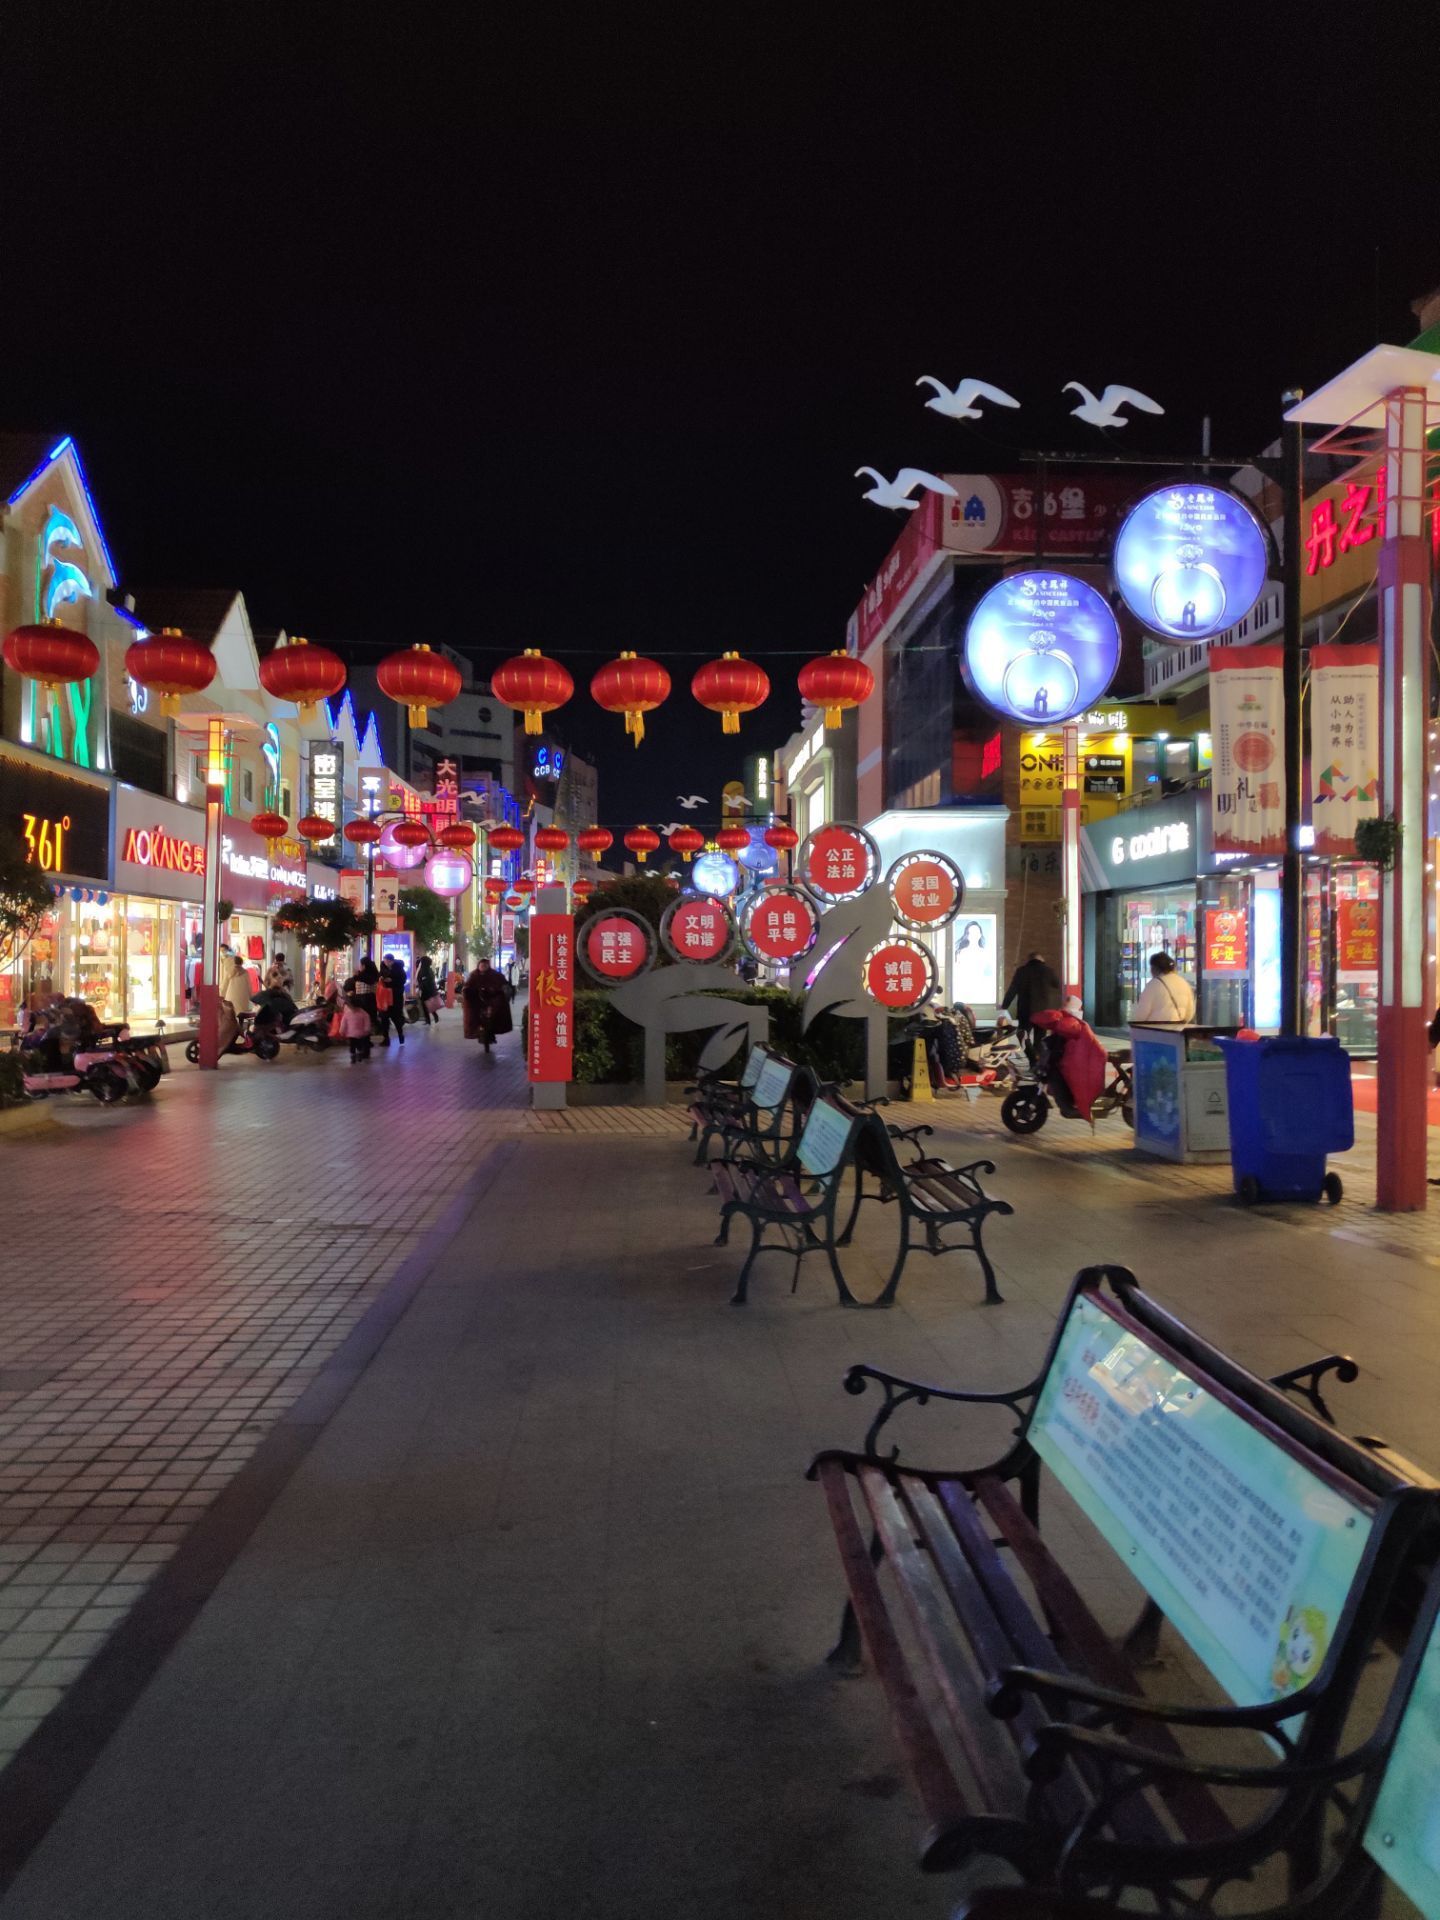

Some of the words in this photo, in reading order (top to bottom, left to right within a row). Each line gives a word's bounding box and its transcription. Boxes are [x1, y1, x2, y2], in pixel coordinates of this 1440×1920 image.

[1330, 695, 1342, 748] 从小培养
[1343, 695, 1355, 748] 助人为乐
[534, 765, 550, 776] CCB
[826, 848, 855, 862] 公正
[827, 864, 855, 878] 法治
[911, 876, 939, 891] 爱国
[911, 893, 940, 907] 敬业
[685, 915, 714, 929] 文明
[767, 911, 796, 925] 自由
[601, 931, 632, 947] 富强
[685, 932, 715, 947] 和谐
[767, 927, 797, 941] 平等
[556, 933, 568, 980] 社会主义
[601, 949, 632, 965] 民主
[884, 962, 913, 976] 诚信
[536, 968, 569, 1009] 核心
[885, 978, 914, 992] 友善
[555, 1012, 568, 1048] 价值观
